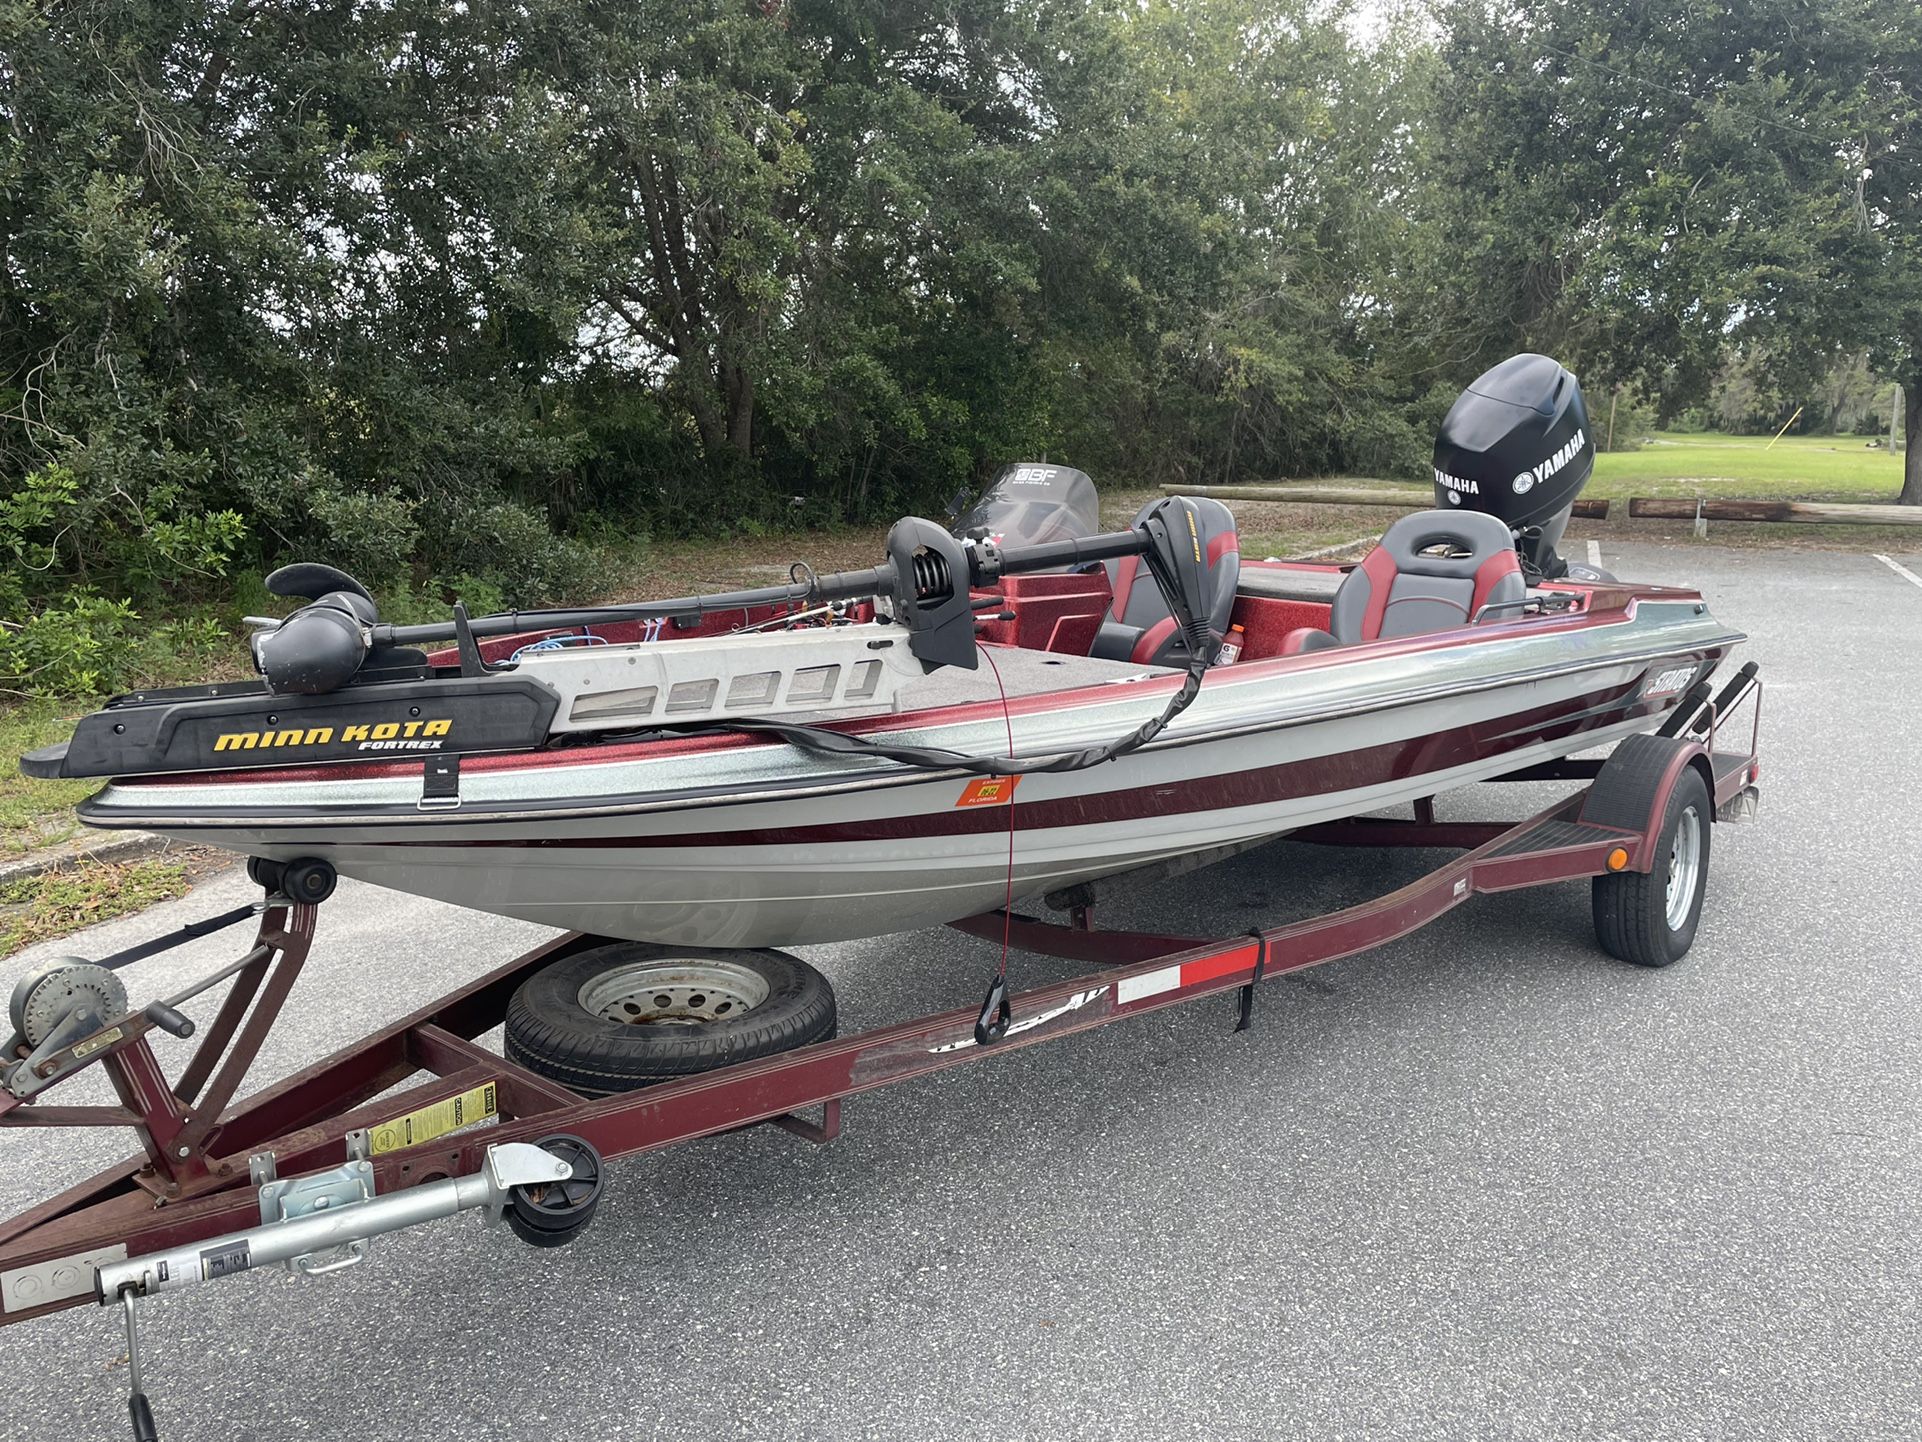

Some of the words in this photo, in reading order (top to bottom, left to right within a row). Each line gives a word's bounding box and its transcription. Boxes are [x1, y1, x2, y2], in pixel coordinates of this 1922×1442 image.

[1533, 428, 1585, 483] YAMAHA
[1434, 467, 1479, 494] YAMAHA
[213, 727, 333, 751] MINN
[340, 719, 453, 742] KOTA
[358, 740, 443, 751] FORTREX
